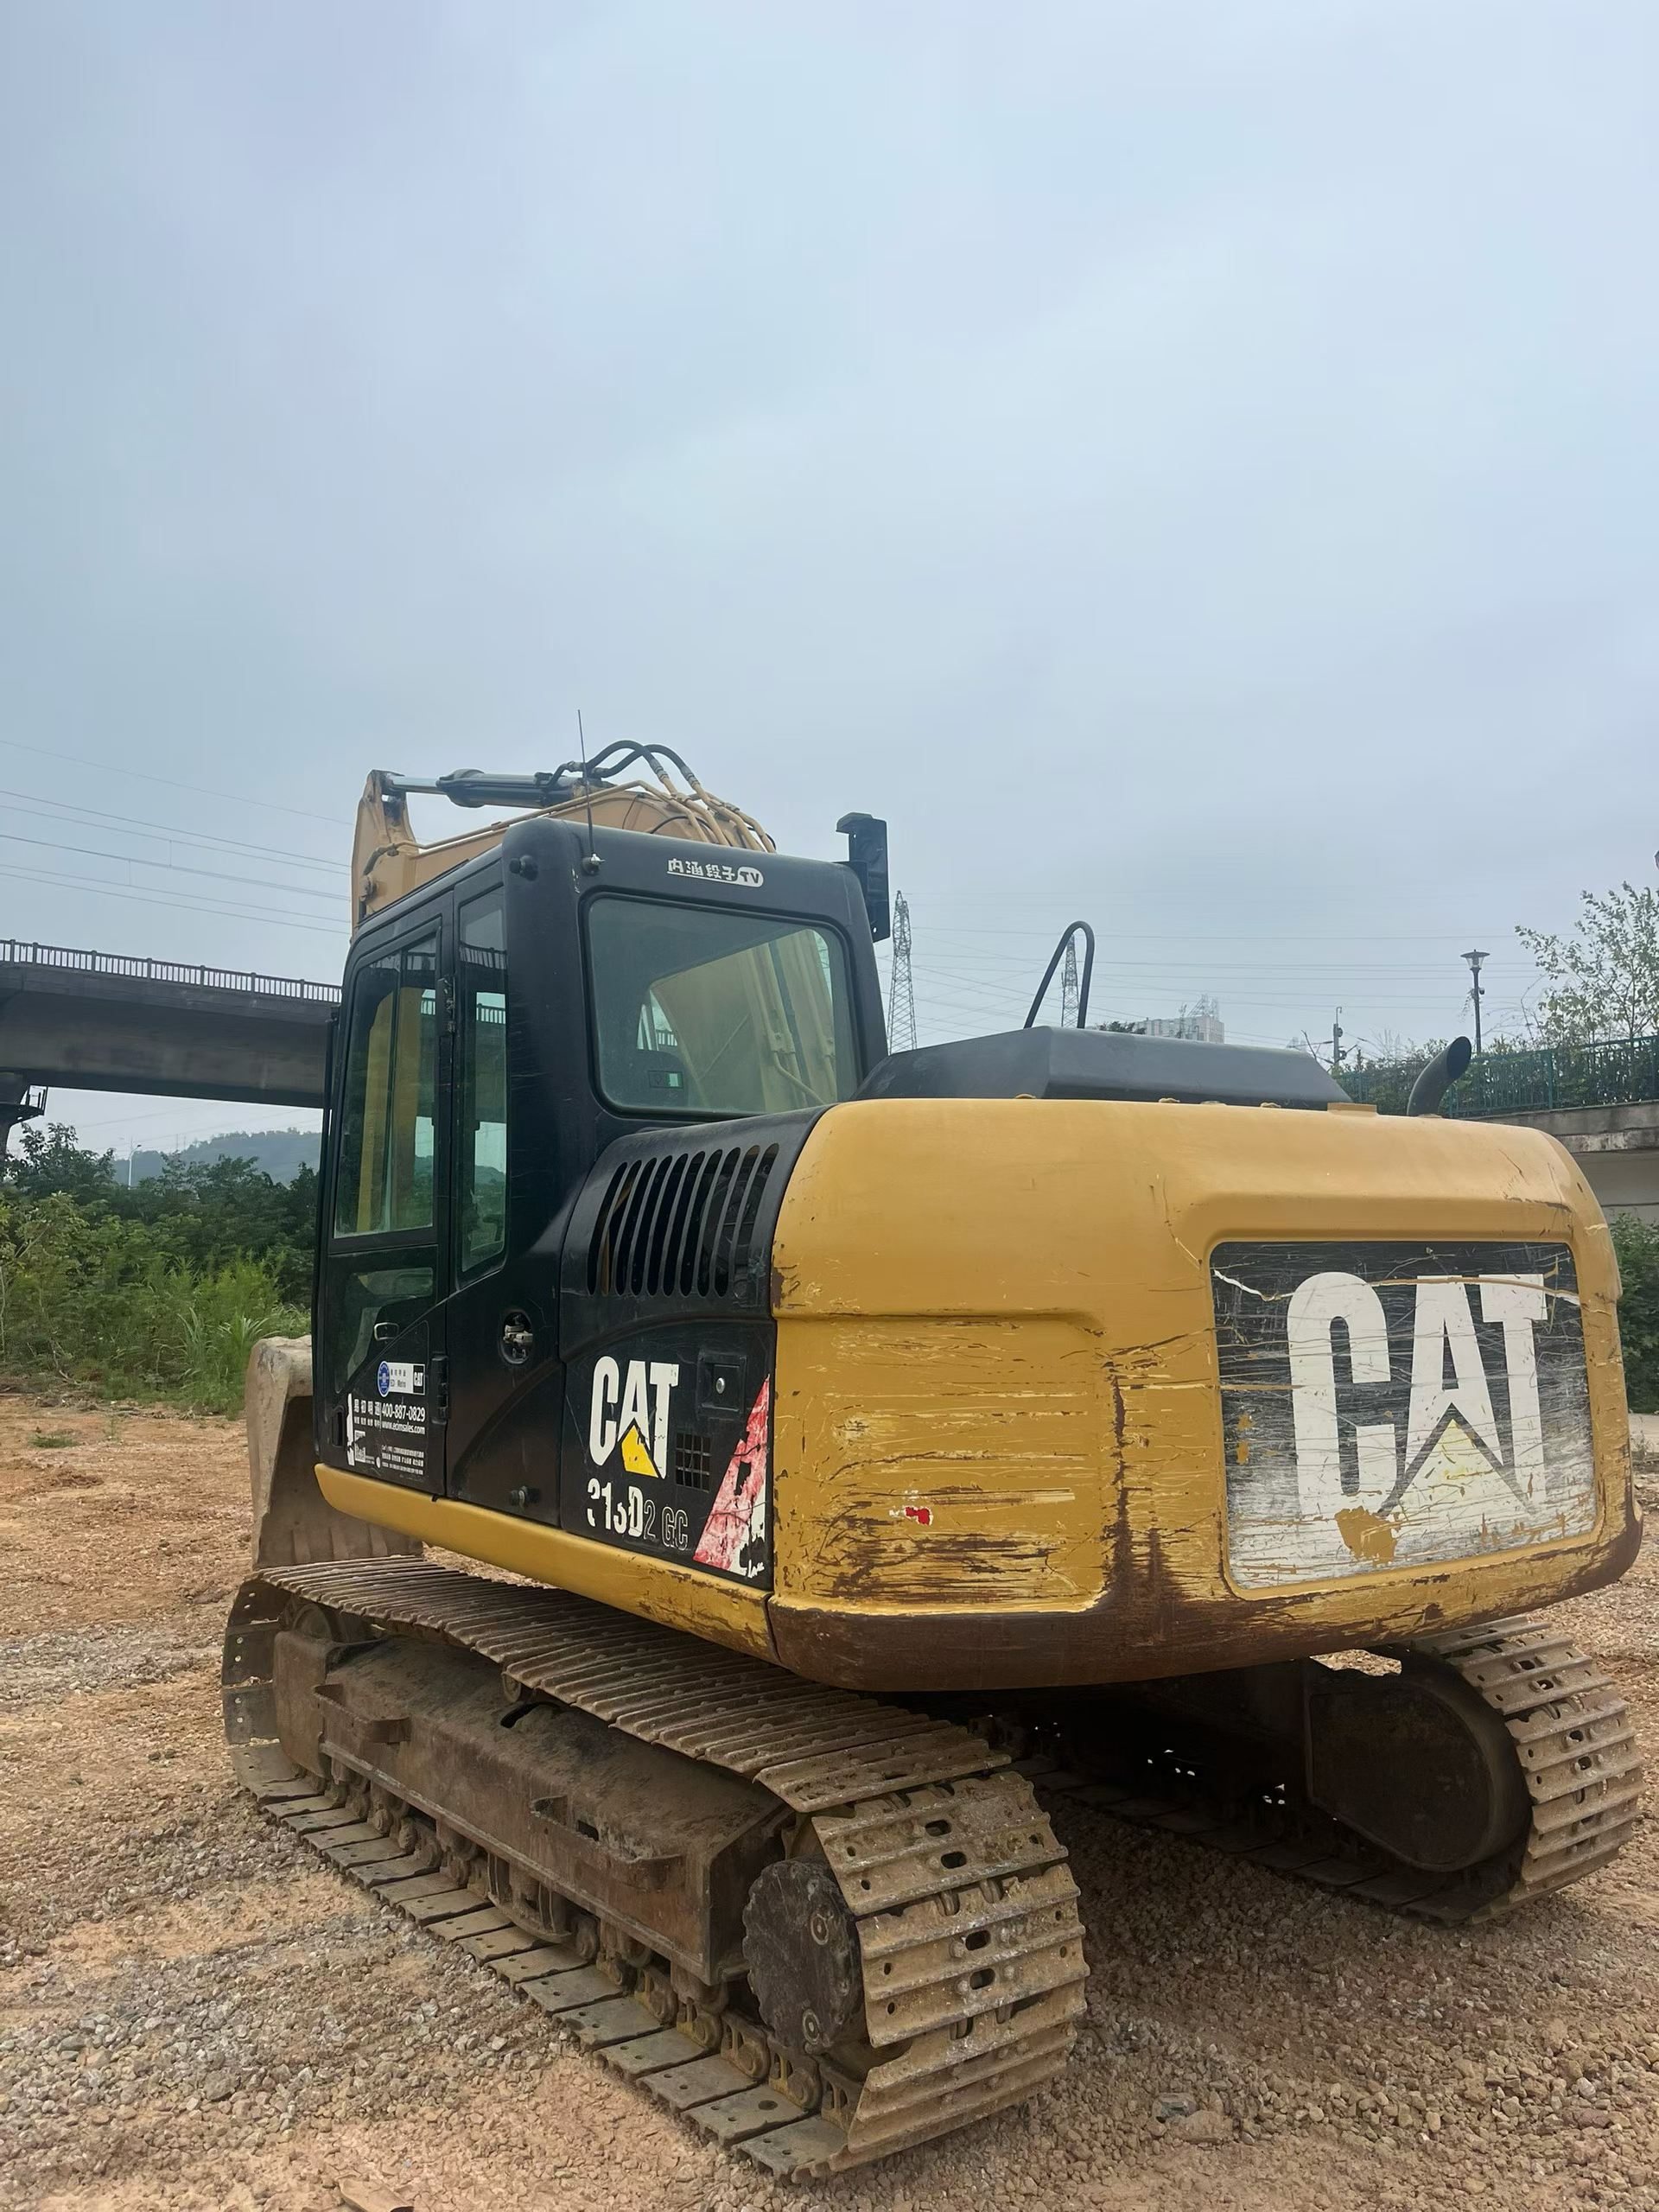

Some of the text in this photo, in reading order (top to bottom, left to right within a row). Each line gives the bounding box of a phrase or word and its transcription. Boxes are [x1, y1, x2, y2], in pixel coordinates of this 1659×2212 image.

[382, 1402, 426, 1422] 400-887-0829
[589, 1356, 679, 1478] CAT
[1287, 1272, 1548, 1517] CAT
